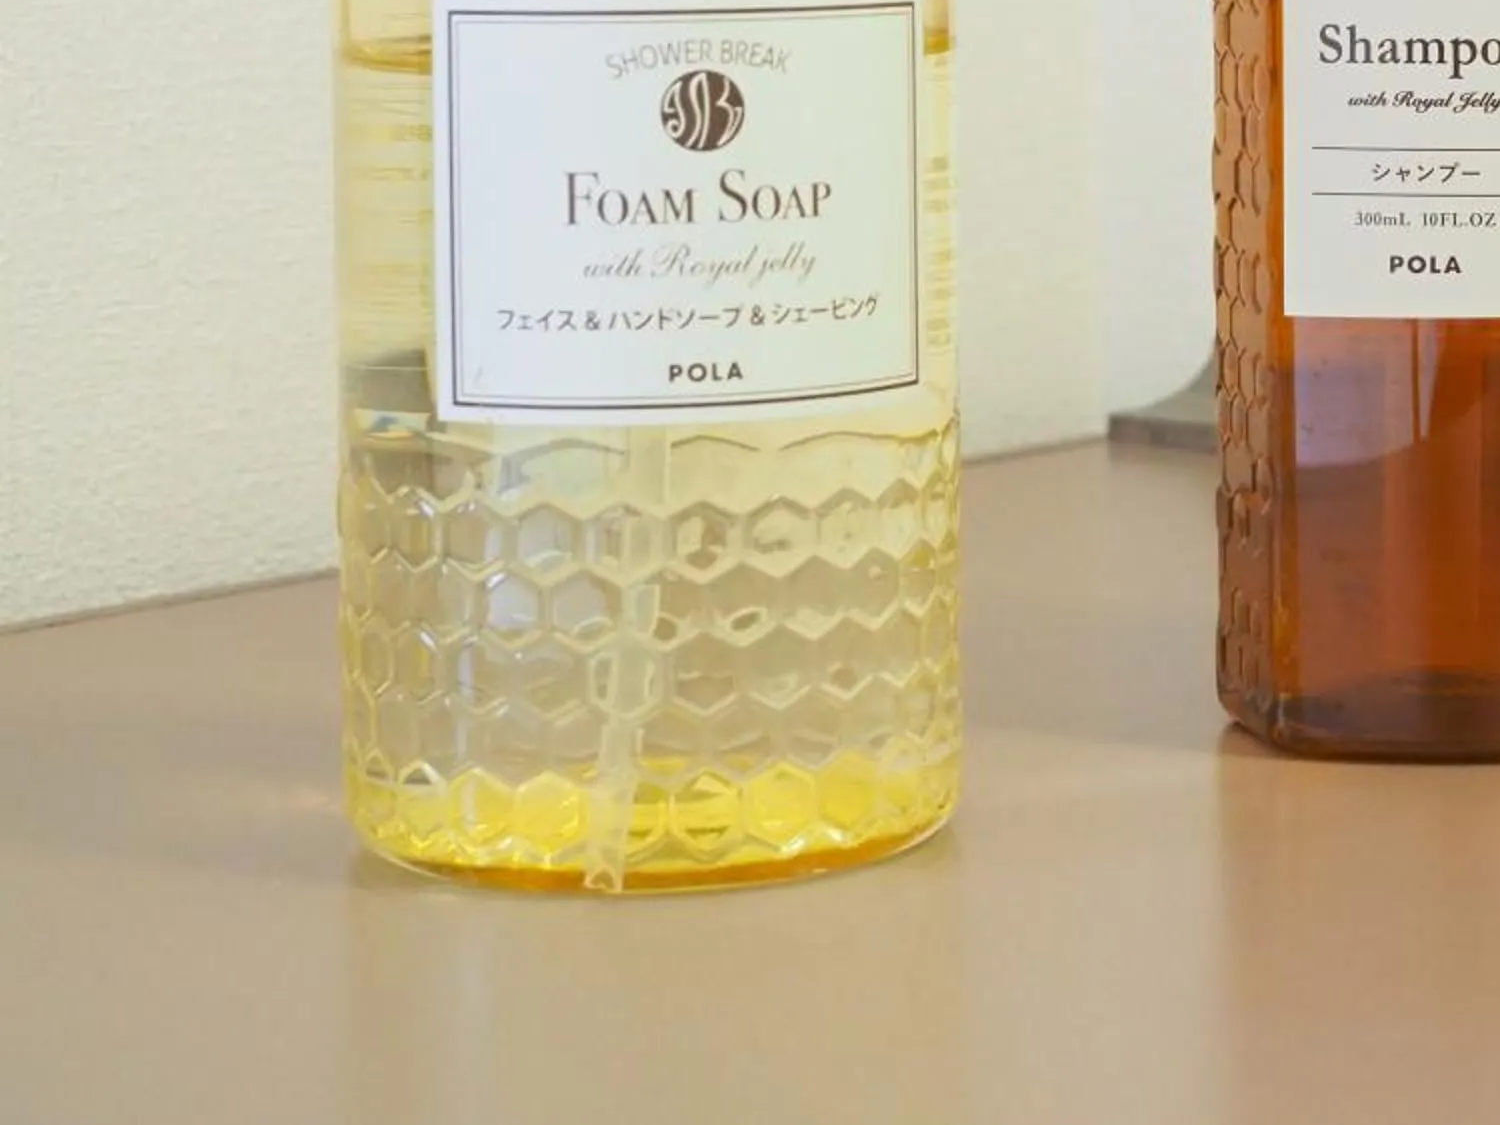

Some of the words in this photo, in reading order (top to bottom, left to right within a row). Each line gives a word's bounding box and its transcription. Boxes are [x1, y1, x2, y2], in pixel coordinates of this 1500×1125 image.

[606, 39, 714, 79] SHOWER
[720, 39, 791, 75] BREAK
[1347, 90, 1388, 108] with
[1391, 90, 1454, 114] Royal
[1371, 161, 1481, 184] シャンプー
[564, 171, 695, 226] FOAM
[718, 169, 832, 222] SOAP
[1353, 210, 1412, 227] 300mL
[1422, 212, 1497, 228] 10FL.OZ
[582, 248, 644, 278] with
[650, 242, 755, 289] Royal
[757, 239, 817, 286] jelly
[1389, 254, 1463, 275] POLA
[668, 361, 744, 383] POLA
